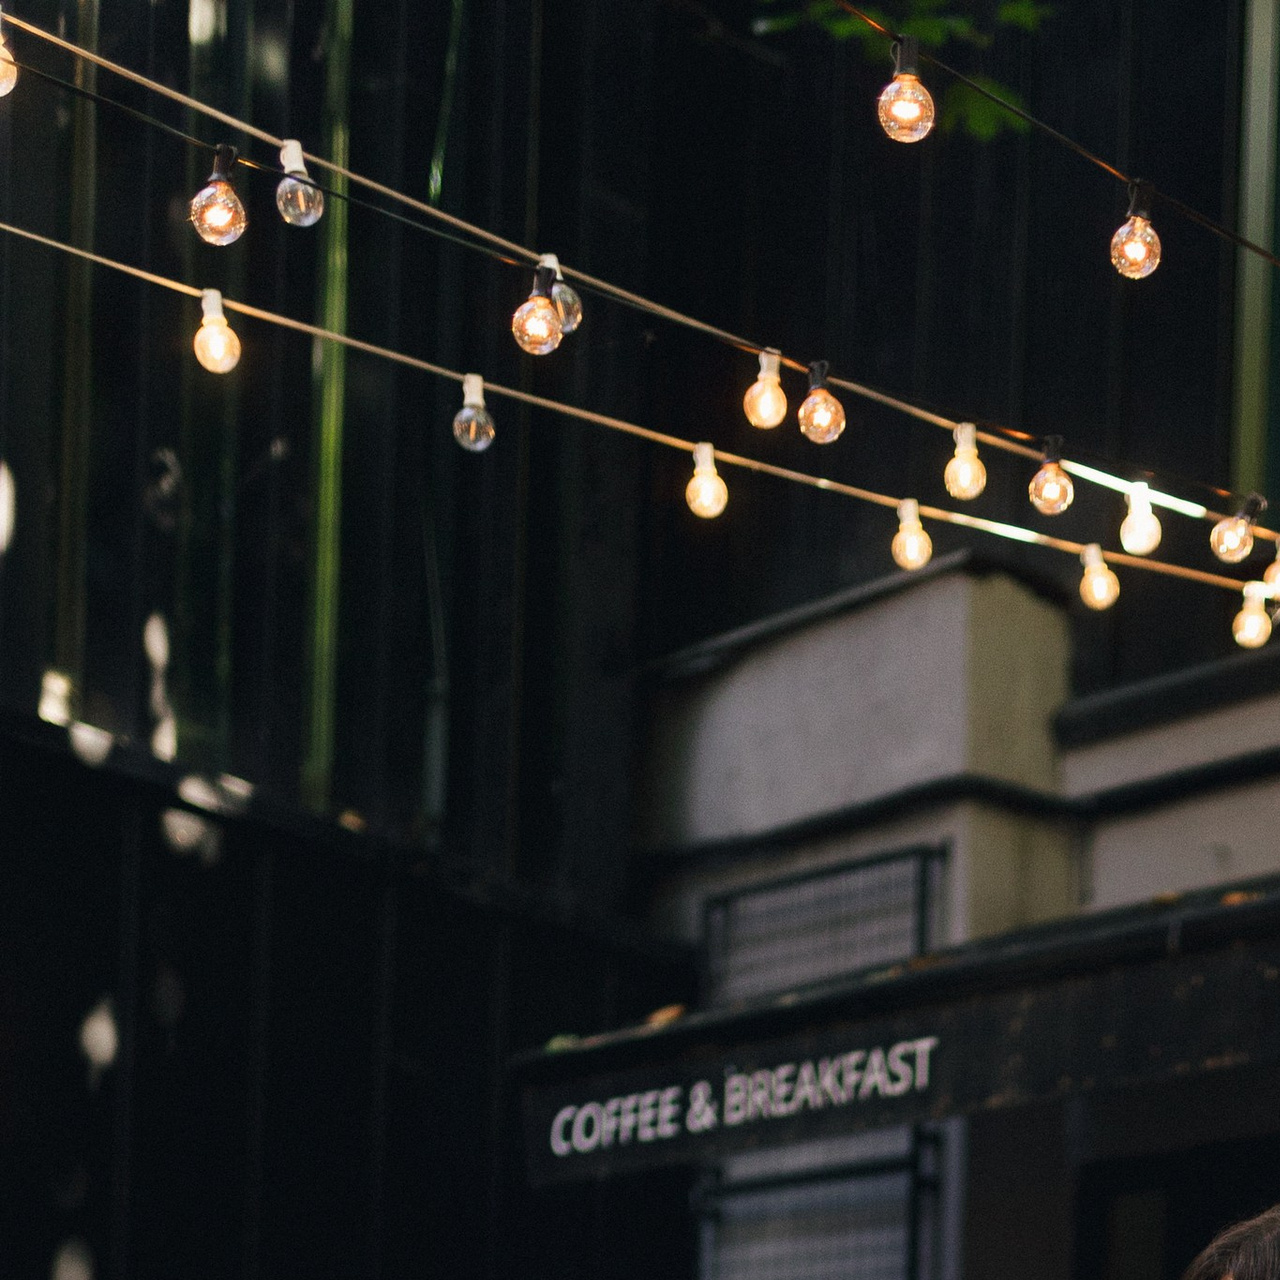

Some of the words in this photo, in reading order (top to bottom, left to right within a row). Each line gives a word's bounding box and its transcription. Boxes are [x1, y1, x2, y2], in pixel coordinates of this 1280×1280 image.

[550, 1086, 682, 1156] COFFEE
[686, 1081, 718, 1133] &
[723, 1037, 939, 1126] BREAKFAST
